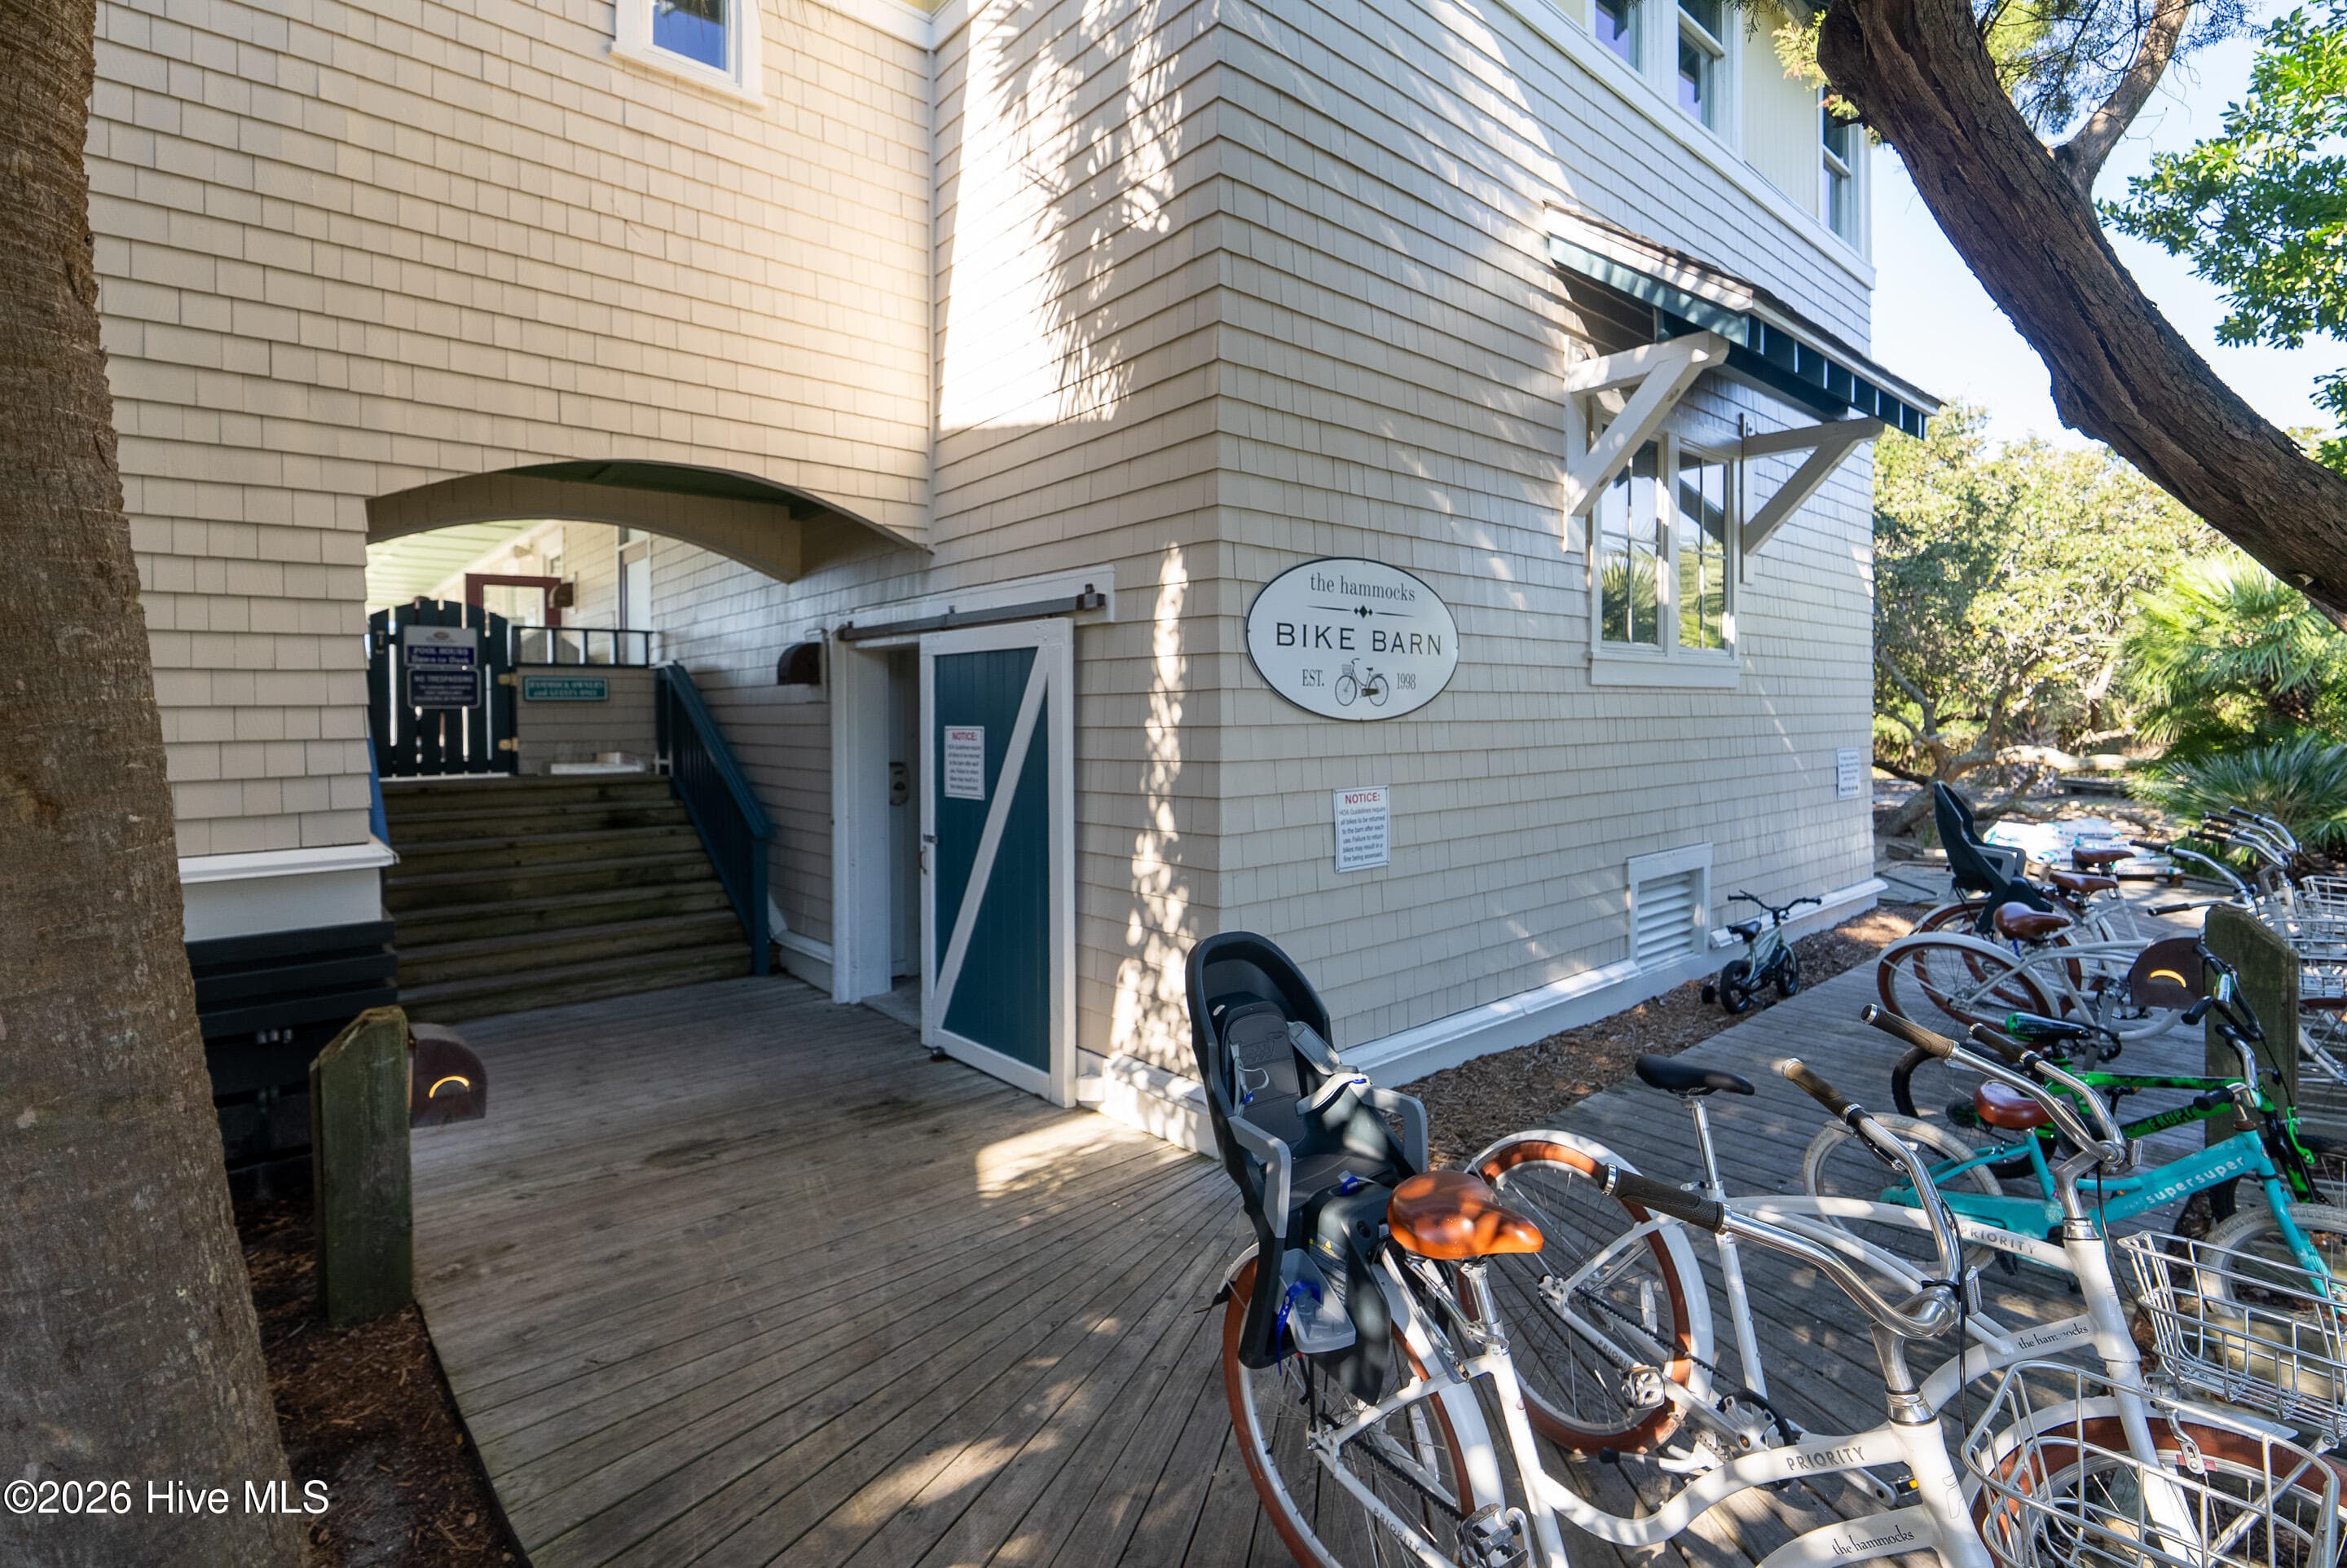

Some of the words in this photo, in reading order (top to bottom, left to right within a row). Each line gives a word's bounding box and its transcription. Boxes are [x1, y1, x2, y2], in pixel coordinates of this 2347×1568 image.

[1310, 573, 1334, 593] the
[1341, 576, 1416, 601] hammocks
[1276, 622, 1355, 650] BIKE
[1372, 630, 1441, 655] BARN
[1301, 669, 1324, 687] EST.
[1396, 672, 1416, 690] 1998
[952, 732, 977, 741] NOTICE:
[1345, 792, 1380, 804] NOTICE:
[2146, 1156, 2244, 1204] supersuper
[1961, 1225, 2036, 1254] PRIORITY
[1597, 1339, 1632, 1370] PRIORIT
[2018, 1337, 2034, 1350] the
[1786, 1446, 1865, 1470] PRIORITY
[1373, 1507, 1420, 1553] PRIORITY
[1832, 1538, 1852, 1555] the
[1848, 1524, 1915, 1551] hammocks
